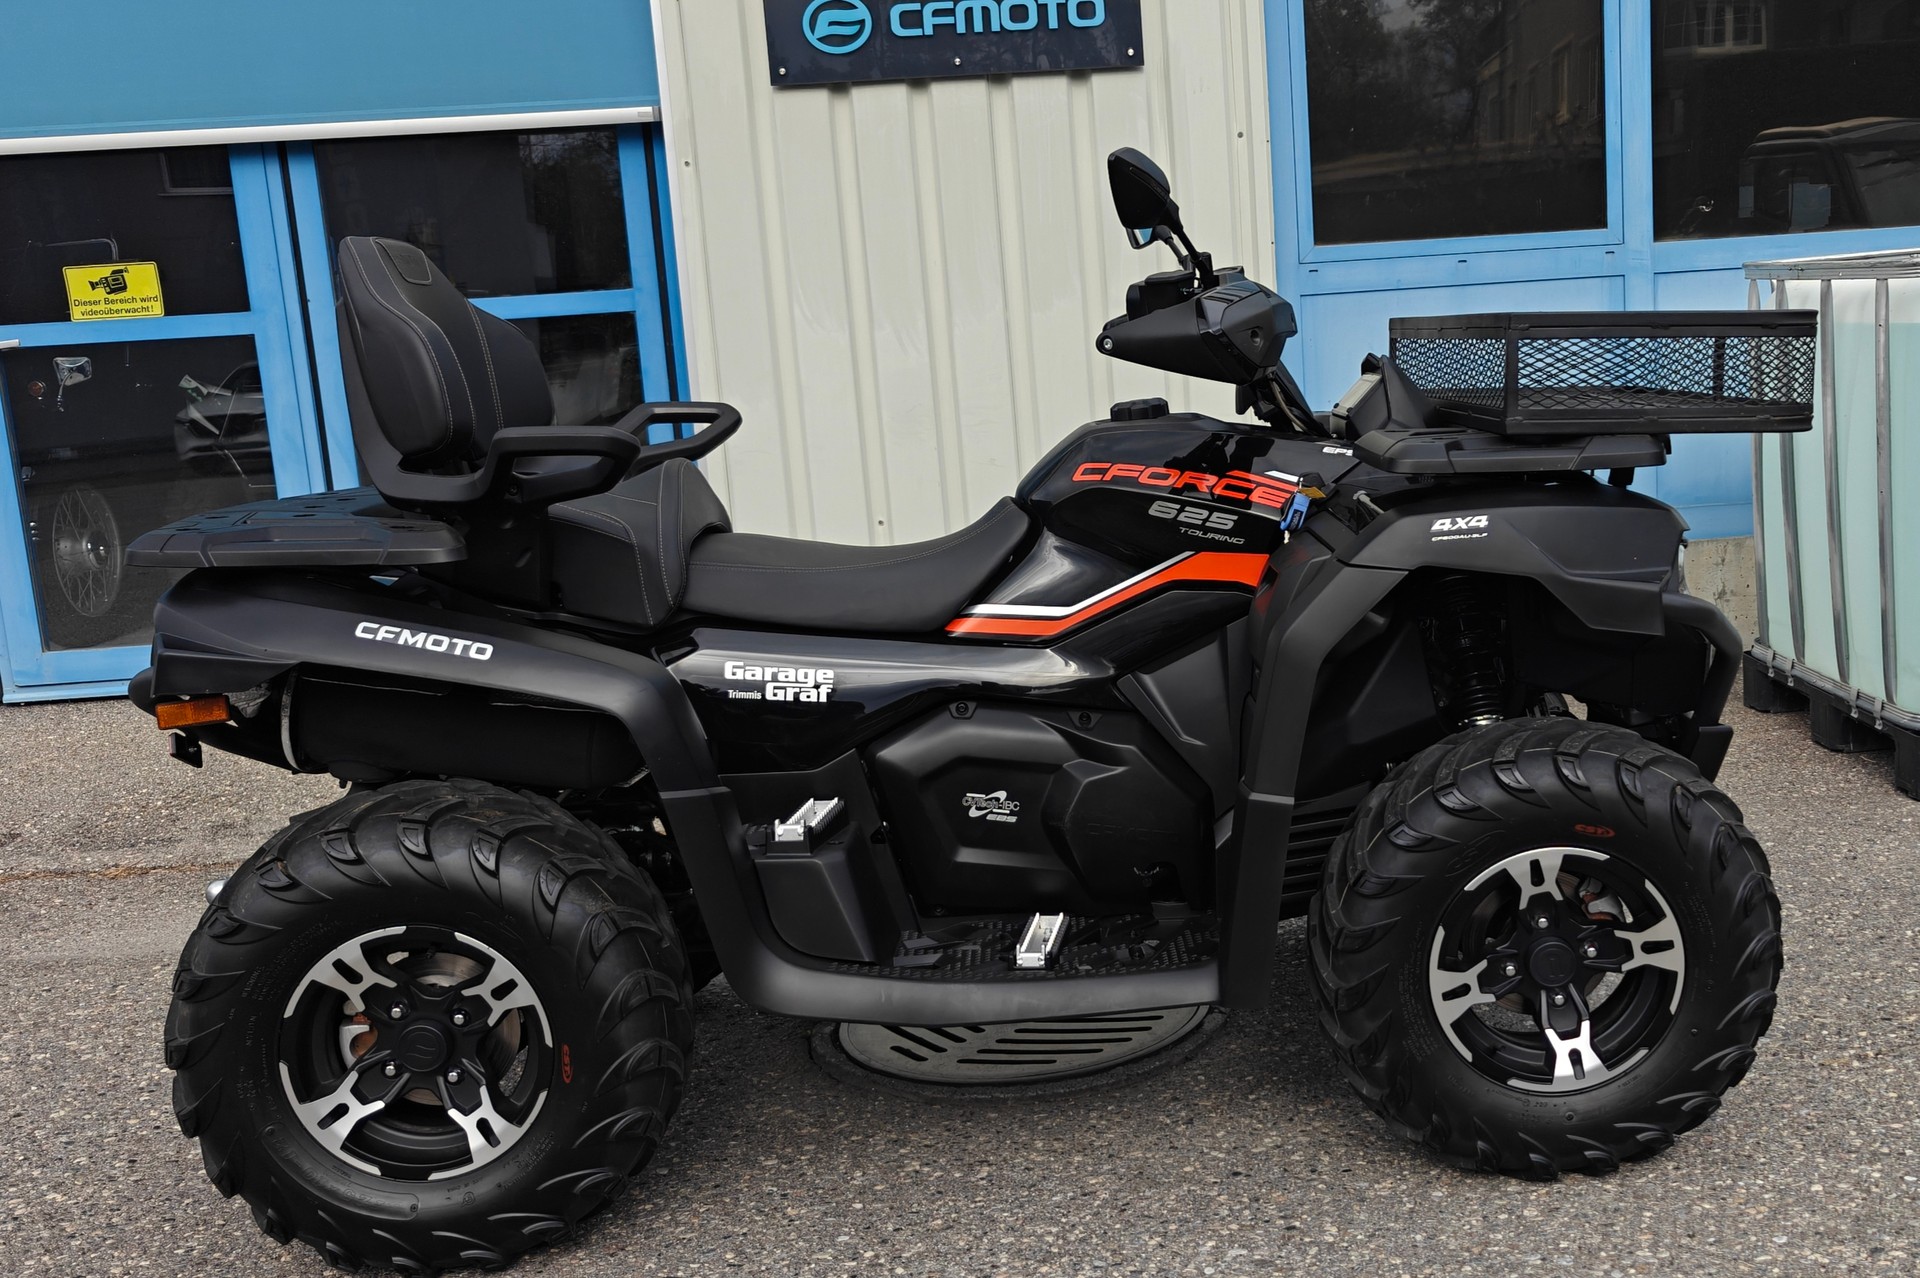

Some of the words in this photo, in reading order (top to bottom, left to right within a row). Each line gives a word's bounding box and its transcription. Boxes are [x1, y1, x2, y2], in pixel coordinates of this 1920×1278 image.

[889, 0, 1106, 37] CFMOTO
[73, 298, 101, 307] Dieser
[103, 296, 138, 305] Bereich
[139, 295, 159, 304] wird
[1071, 462, 1299, 509] CFORCE
[1148, 500, 1238, 530] 625
[1179, 526, 1246, 545] TOURING
[354, 621, 494, 661] CFMOTO
[724, 660, 835, 688] Garage
[727, 689, 762, 700] Trimmis
[765, 681, 834, 703] Graf
